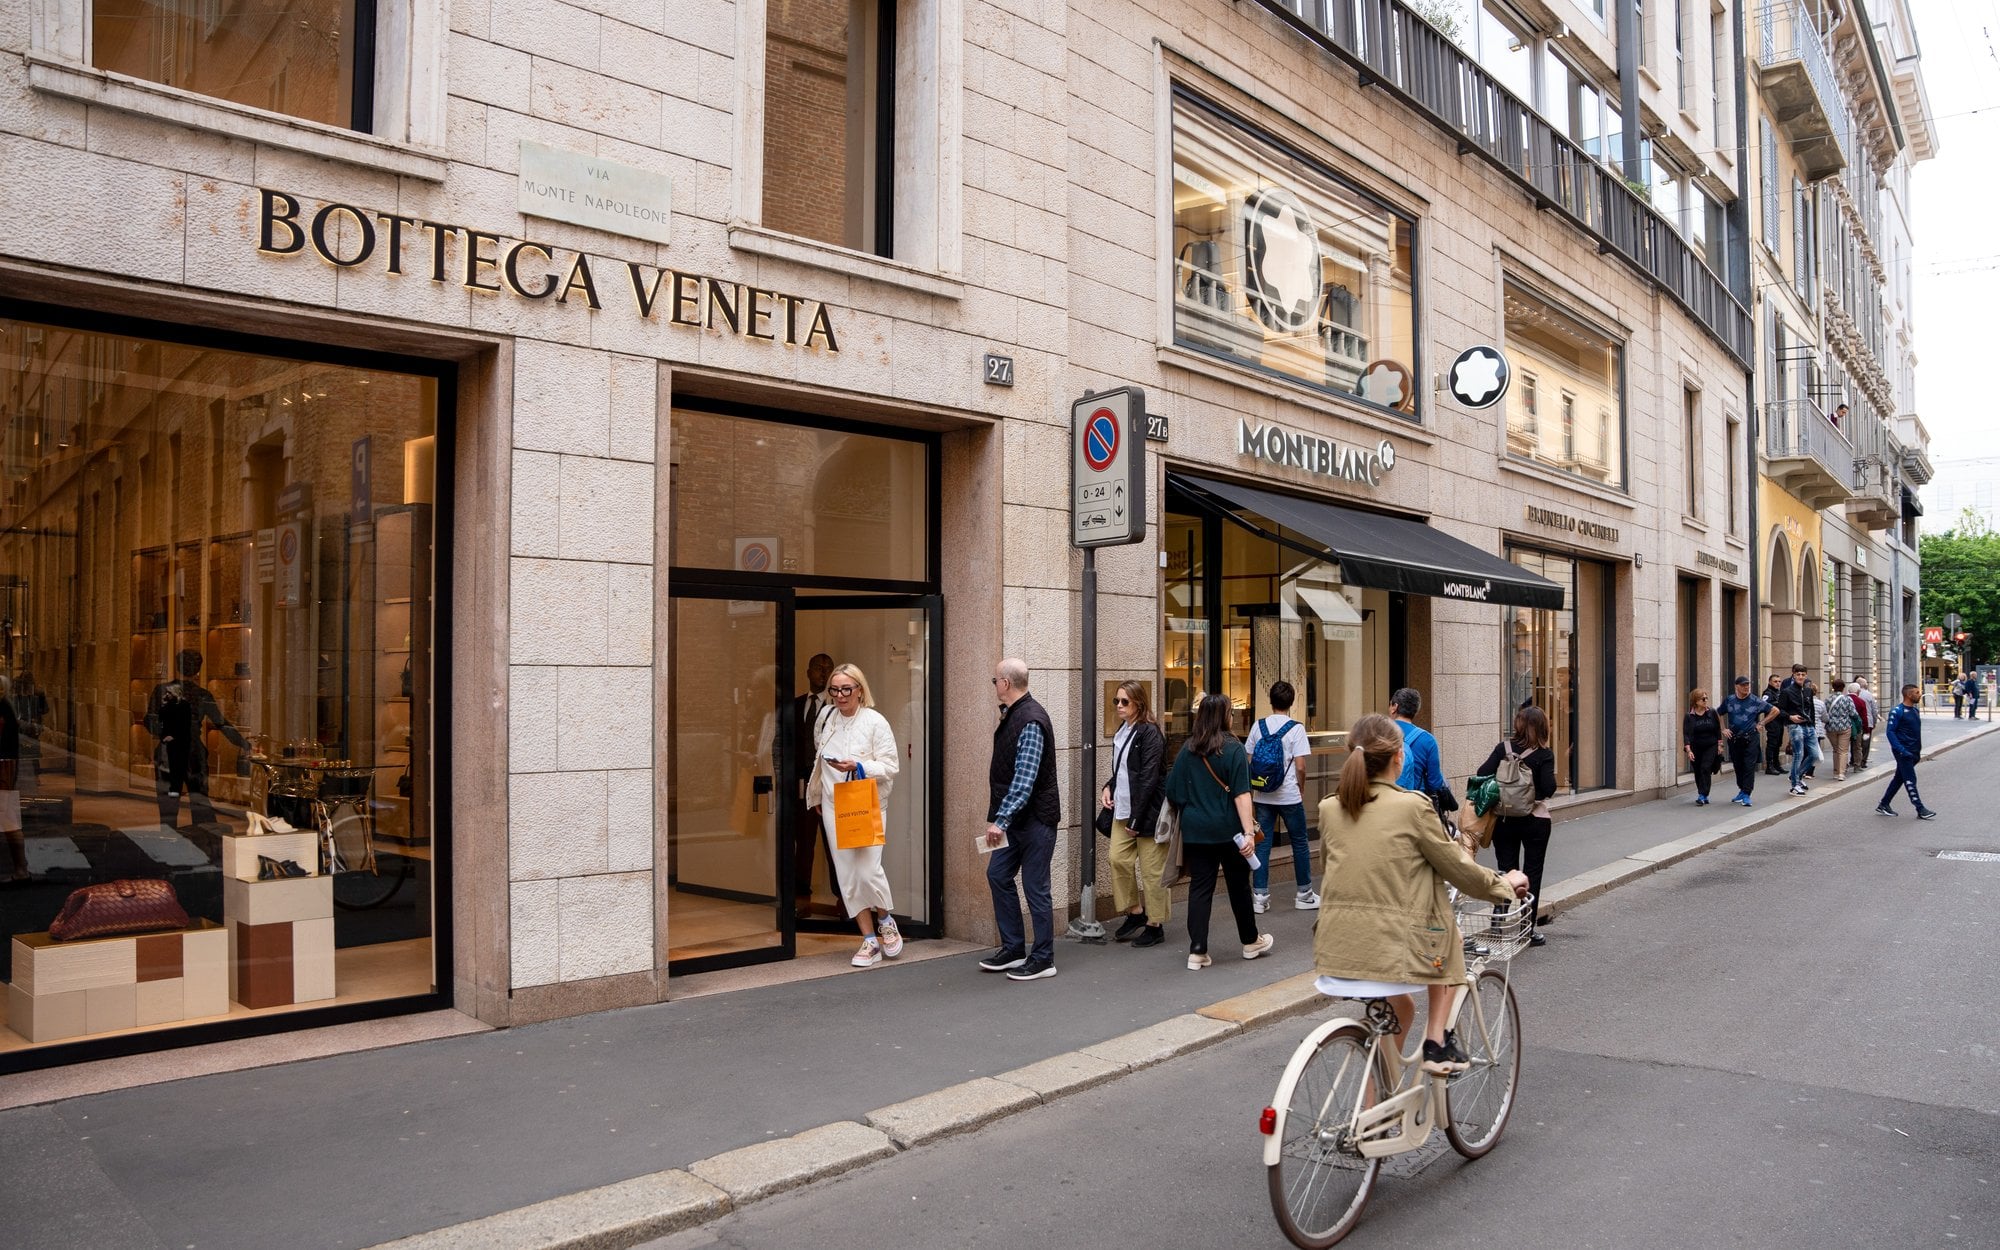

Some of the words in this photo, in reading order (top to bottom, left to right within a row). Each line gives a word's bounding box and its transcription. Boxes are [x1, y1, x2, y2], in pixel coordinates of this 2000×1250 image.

[587, 167, 610, 181] VIA
[524, 180, 575, 203] MONTE
[585, 194, 667, 224] NAPOLEONE
[258, 187, 602, 309] BOTTEGA
[626, 263, 839, 352] VENETA
[1238, 416, 1380, 487] MONTBLANC
[1524, 505, 1576, 532] BRUNELLO
[1577, 519, 1619, 542] CUCINELLI
[1443, 581, 1487, 600] MONTBLANC
